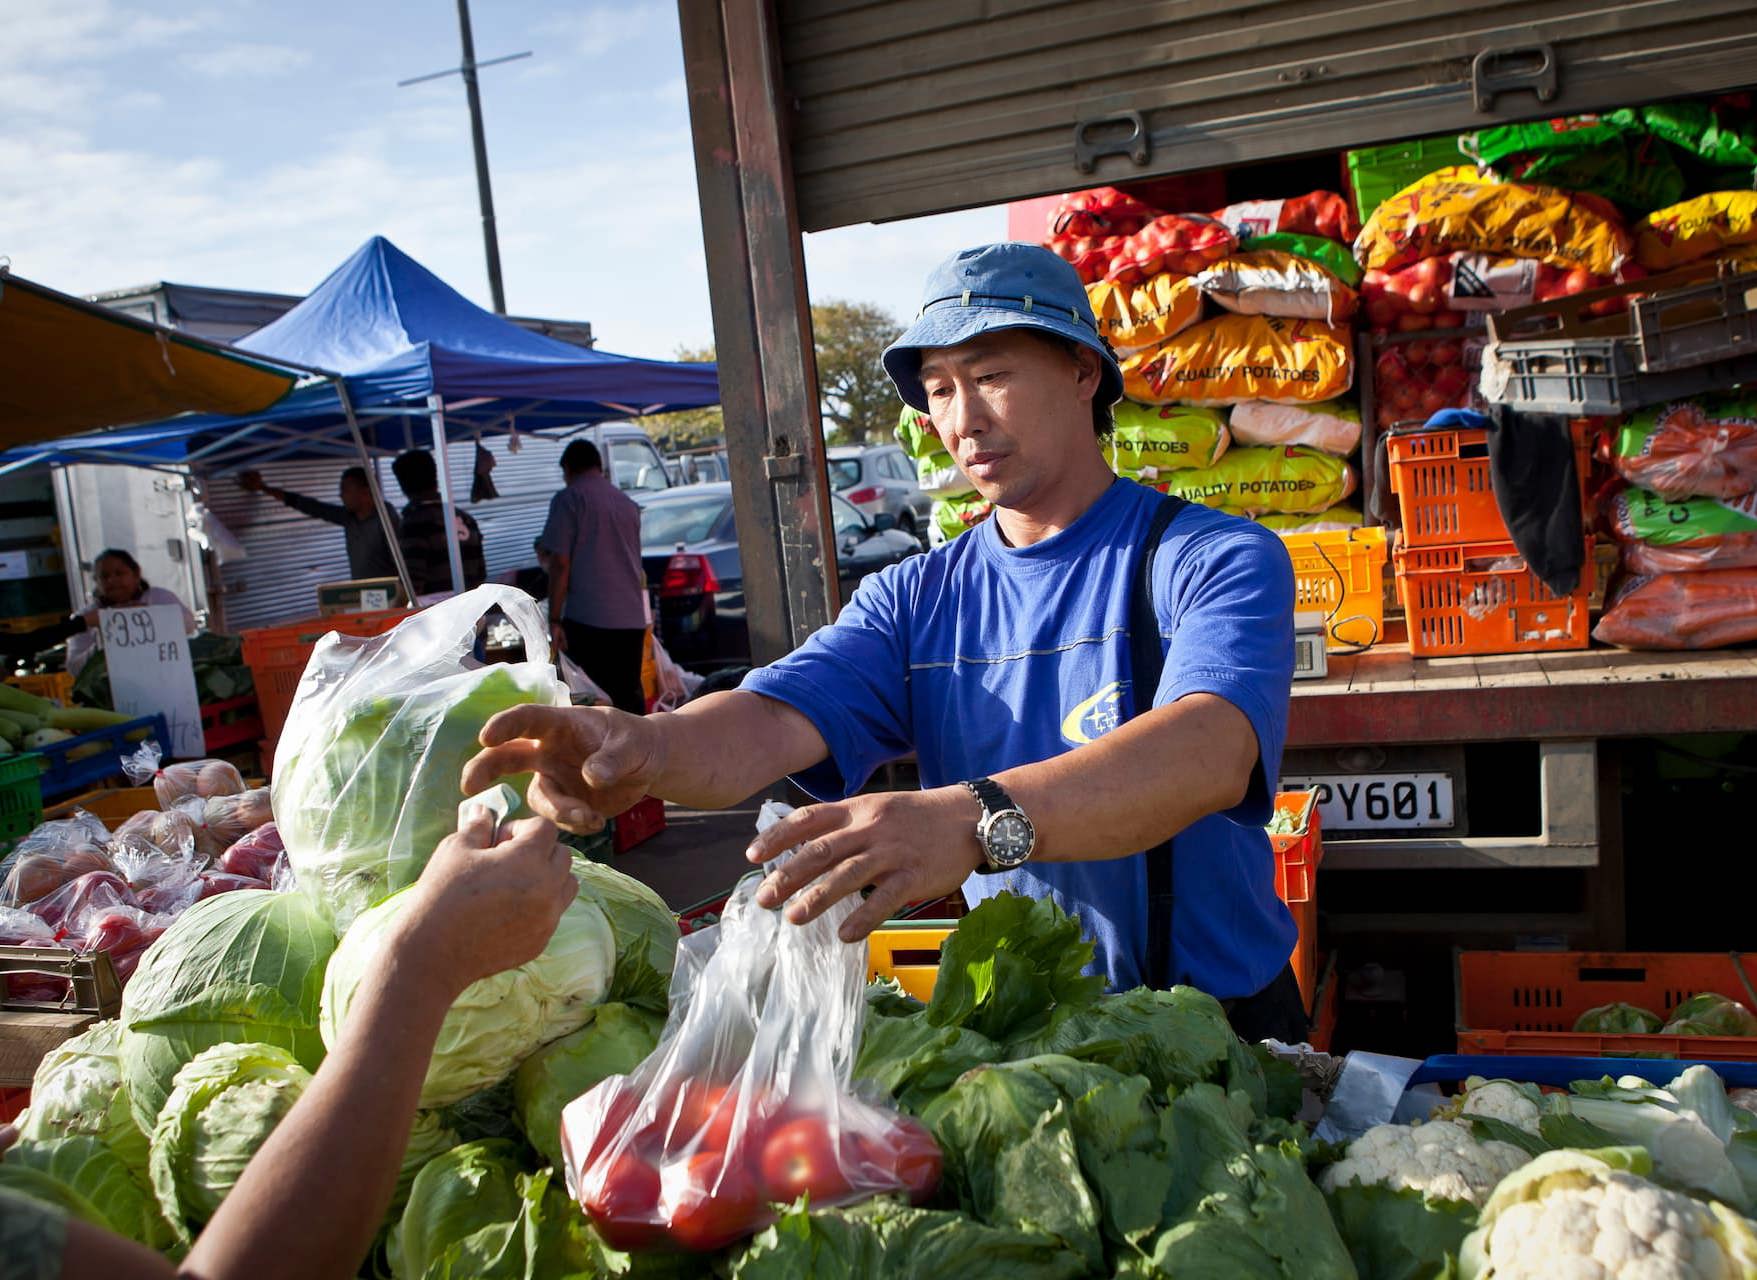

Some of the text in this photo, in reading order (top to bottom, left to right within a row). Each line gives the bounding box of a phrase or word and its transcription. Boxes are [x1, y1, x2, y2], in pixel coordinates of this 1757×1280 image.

[1242, 365, 1321, 383] POTATOES
[1115, 439, 1190, 454] POTATOES
[1180, 479, 1316, 501] UALITY POTATOES
[157, 640, 179, 662] EA
[1283, 780, 1442, 822] PY601
